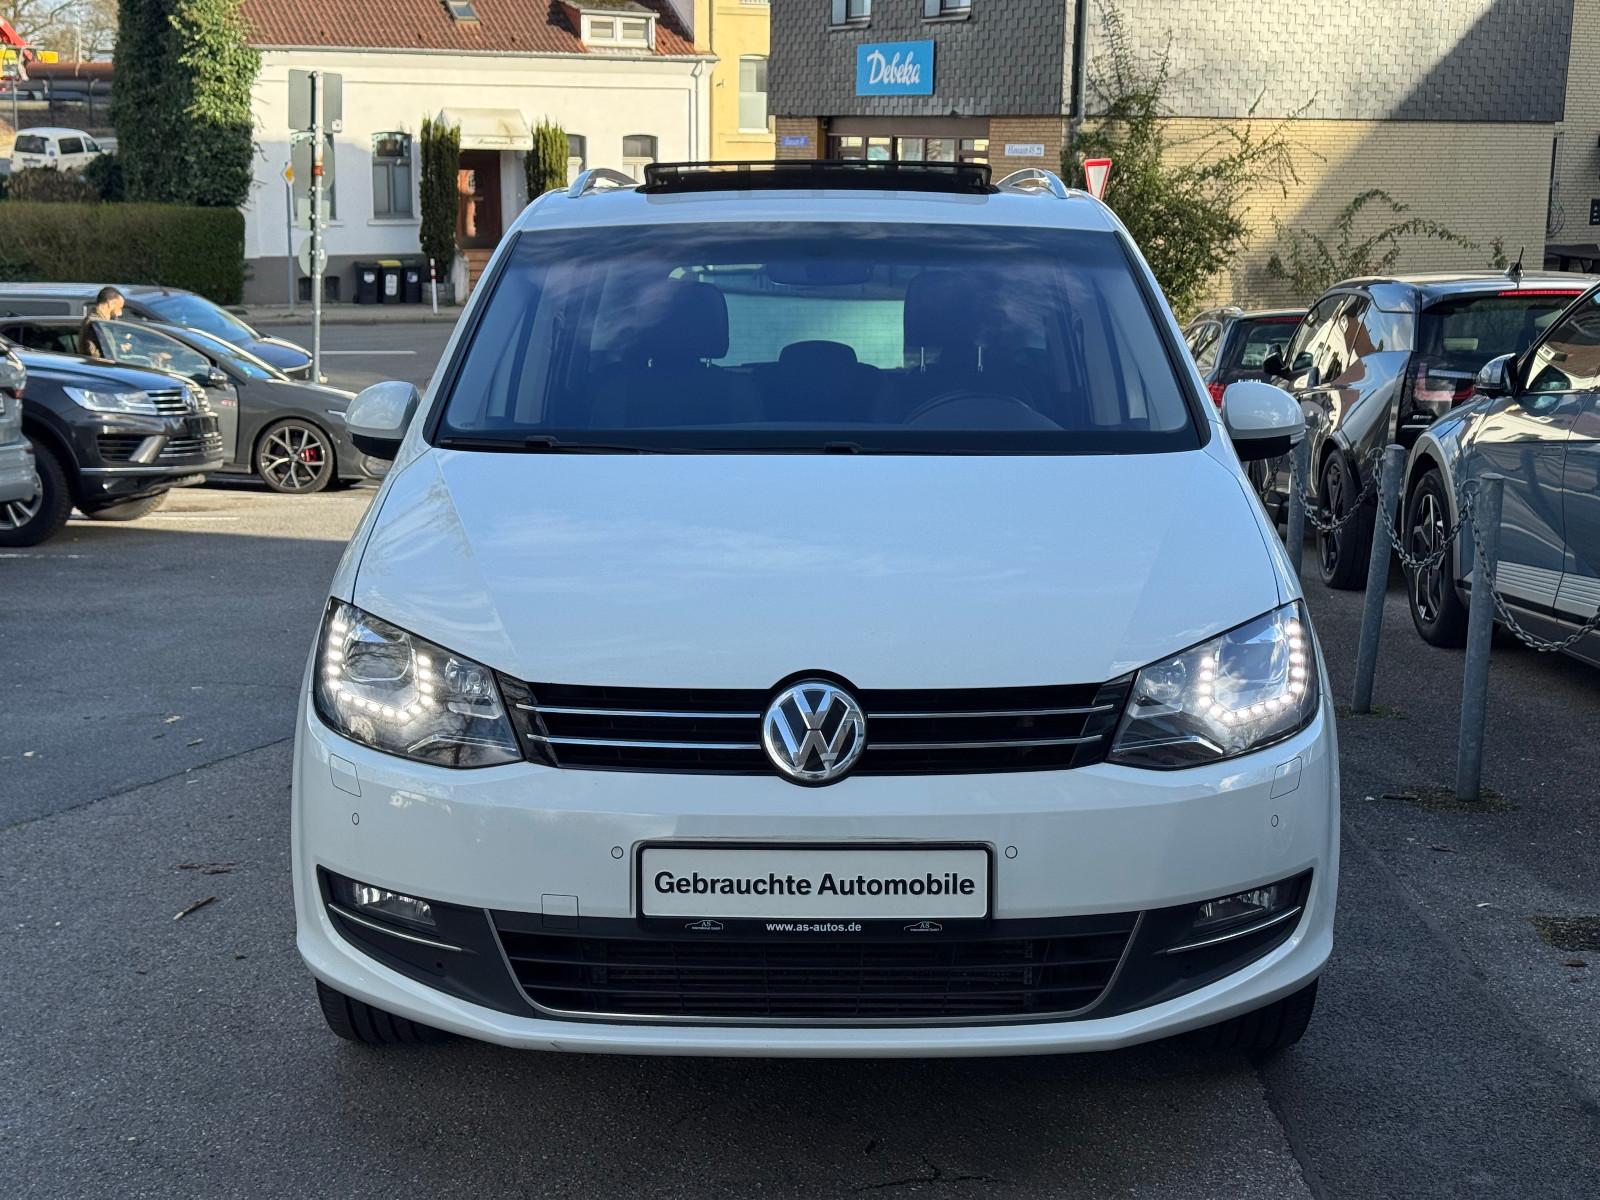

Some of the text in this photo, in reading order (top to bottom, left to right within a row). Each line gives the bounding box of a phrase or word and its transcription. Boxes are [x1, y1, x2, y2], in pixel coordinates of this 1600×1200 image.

[866, 49, 921, 86] Debeka
[654, 871, 975, 896] Gebrauchte Automobile
[766, 922, 862, 932] www.as-autos.de
